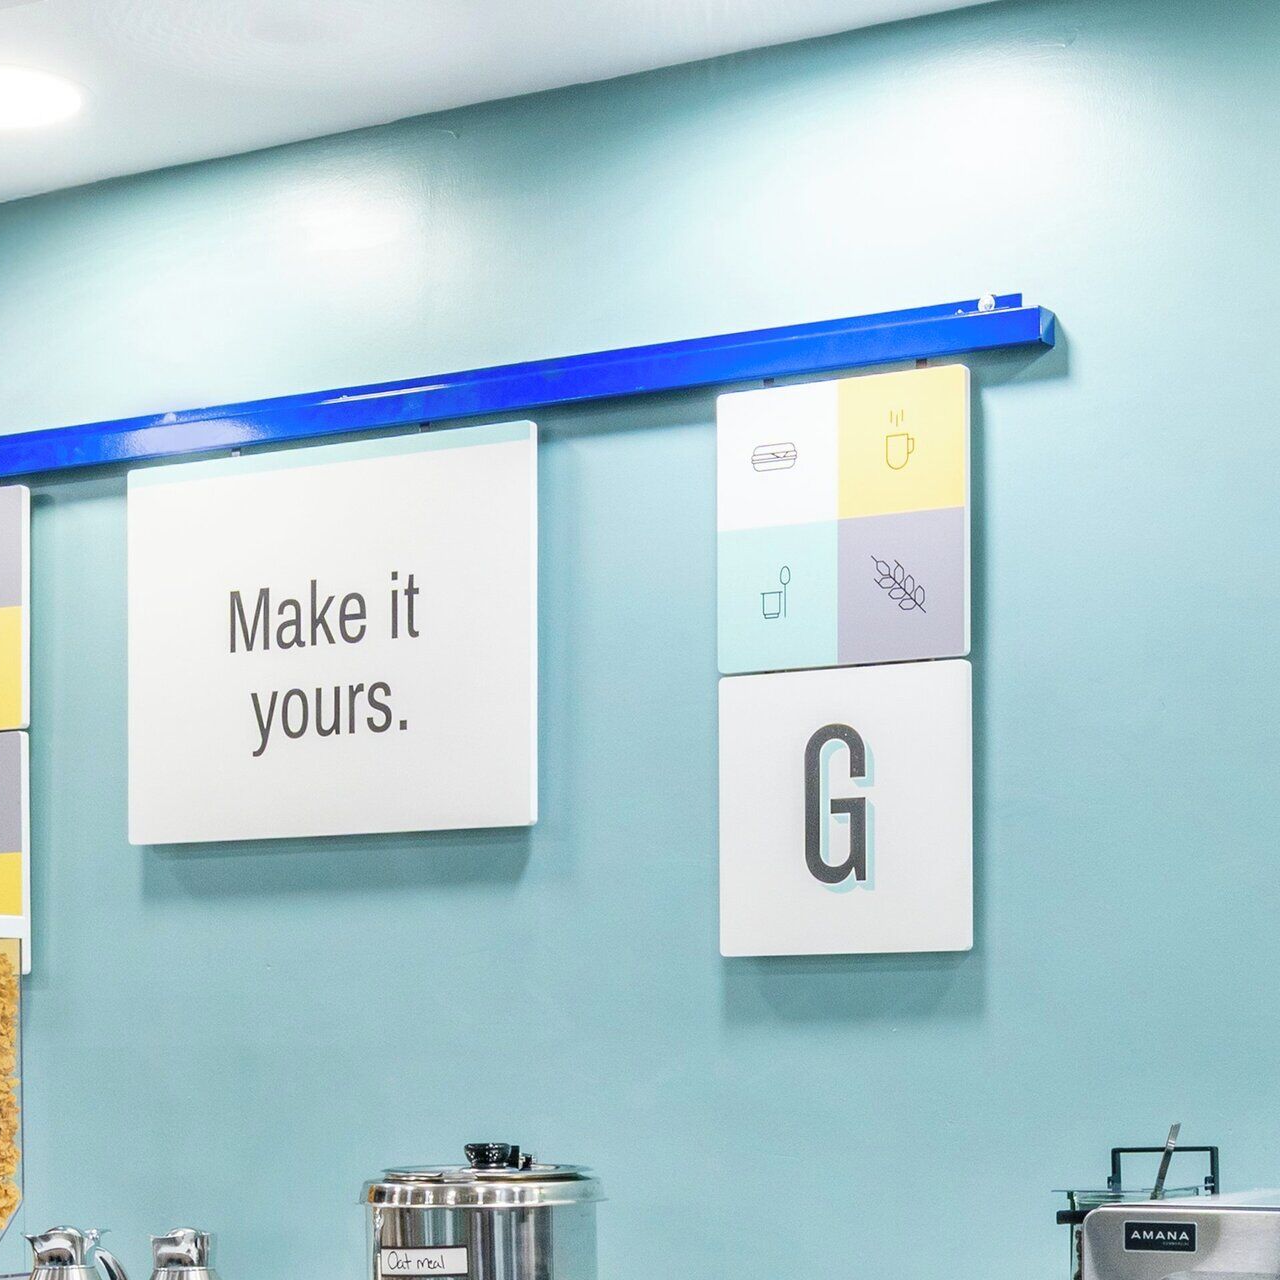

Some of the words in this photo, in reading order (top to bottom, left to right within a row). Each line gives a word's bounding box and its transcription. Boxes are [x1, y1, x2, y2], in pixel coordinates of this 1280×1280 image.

[229, 578, 367, 654] Make
[391, 570, 420, 640] it
[250, 681, 408, 758] yours.
[804, 723, 872, 890] G
[387, 1250, 412, 1270] Oat
[416, 1254, 445, 1270] meal
[1130, 1230, 1189, 1240] AMANA
